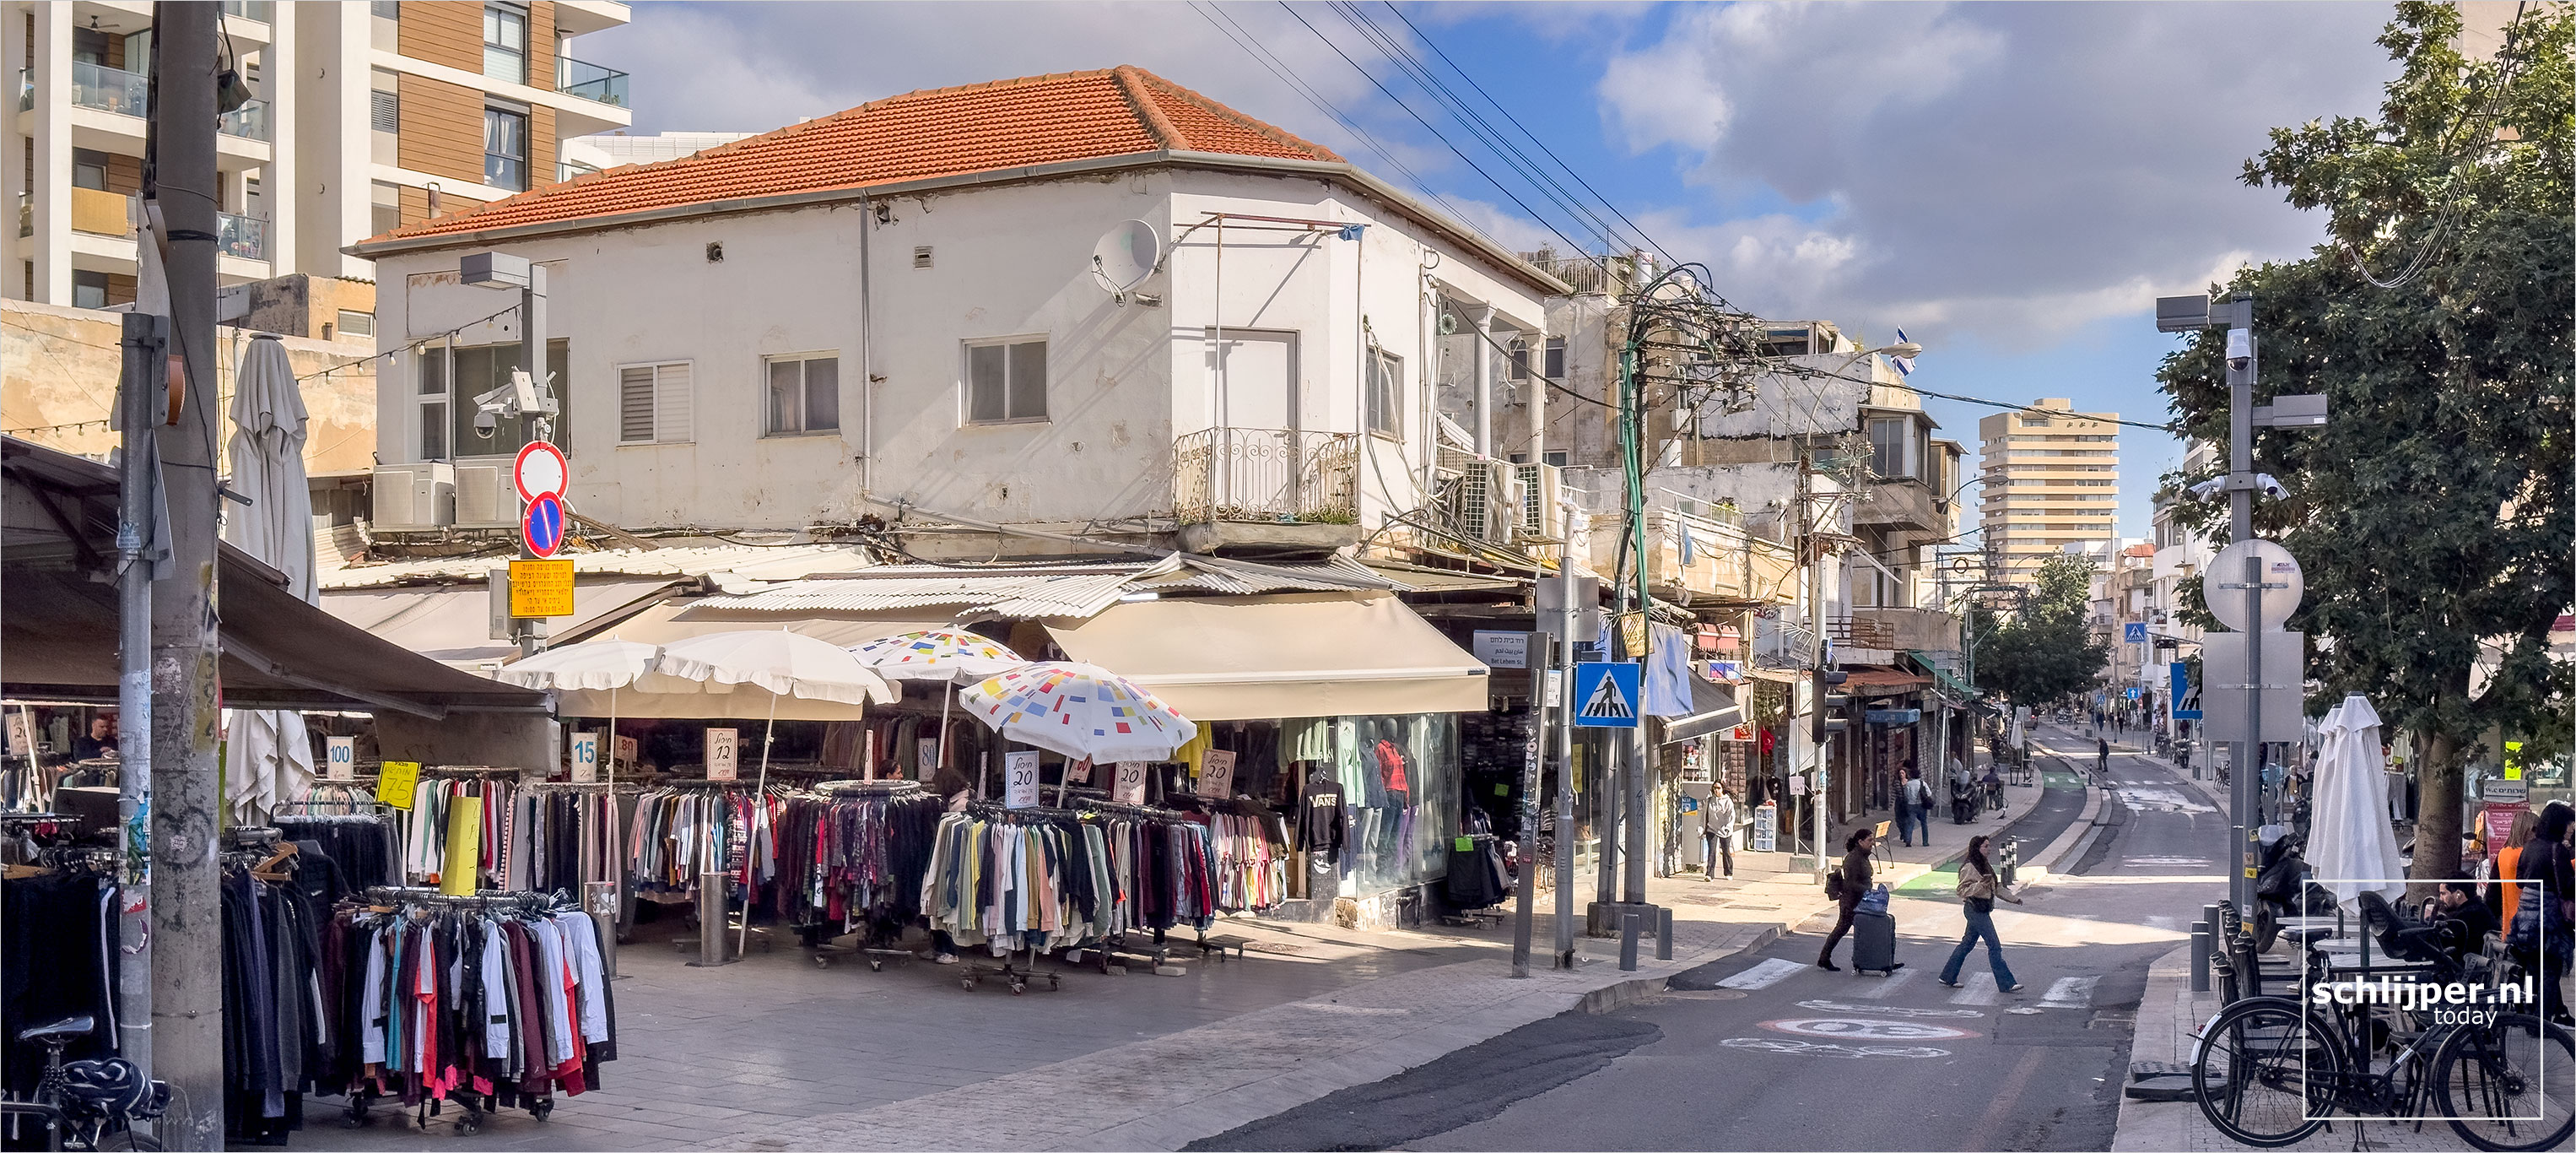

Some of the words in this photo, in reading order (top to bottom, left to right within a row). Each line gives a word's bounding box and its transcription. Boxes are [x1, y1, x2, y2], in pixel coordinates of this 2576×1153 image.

[330, 745, 350, 763] 100
[575, 740, 595, 763] 15
[716, 745, 731, 760] 12
[922, 744, 935, 766] 80
[1013, 756, 1033, 770] חיסול
[1013, 770, 1033, 787] 20
[1121, 768, 1139, 783] 20
[1206, 765, 1227, 779] 20
[386, 777, 413, 801] 75
[1309, 793, 1337, 808] VANS
